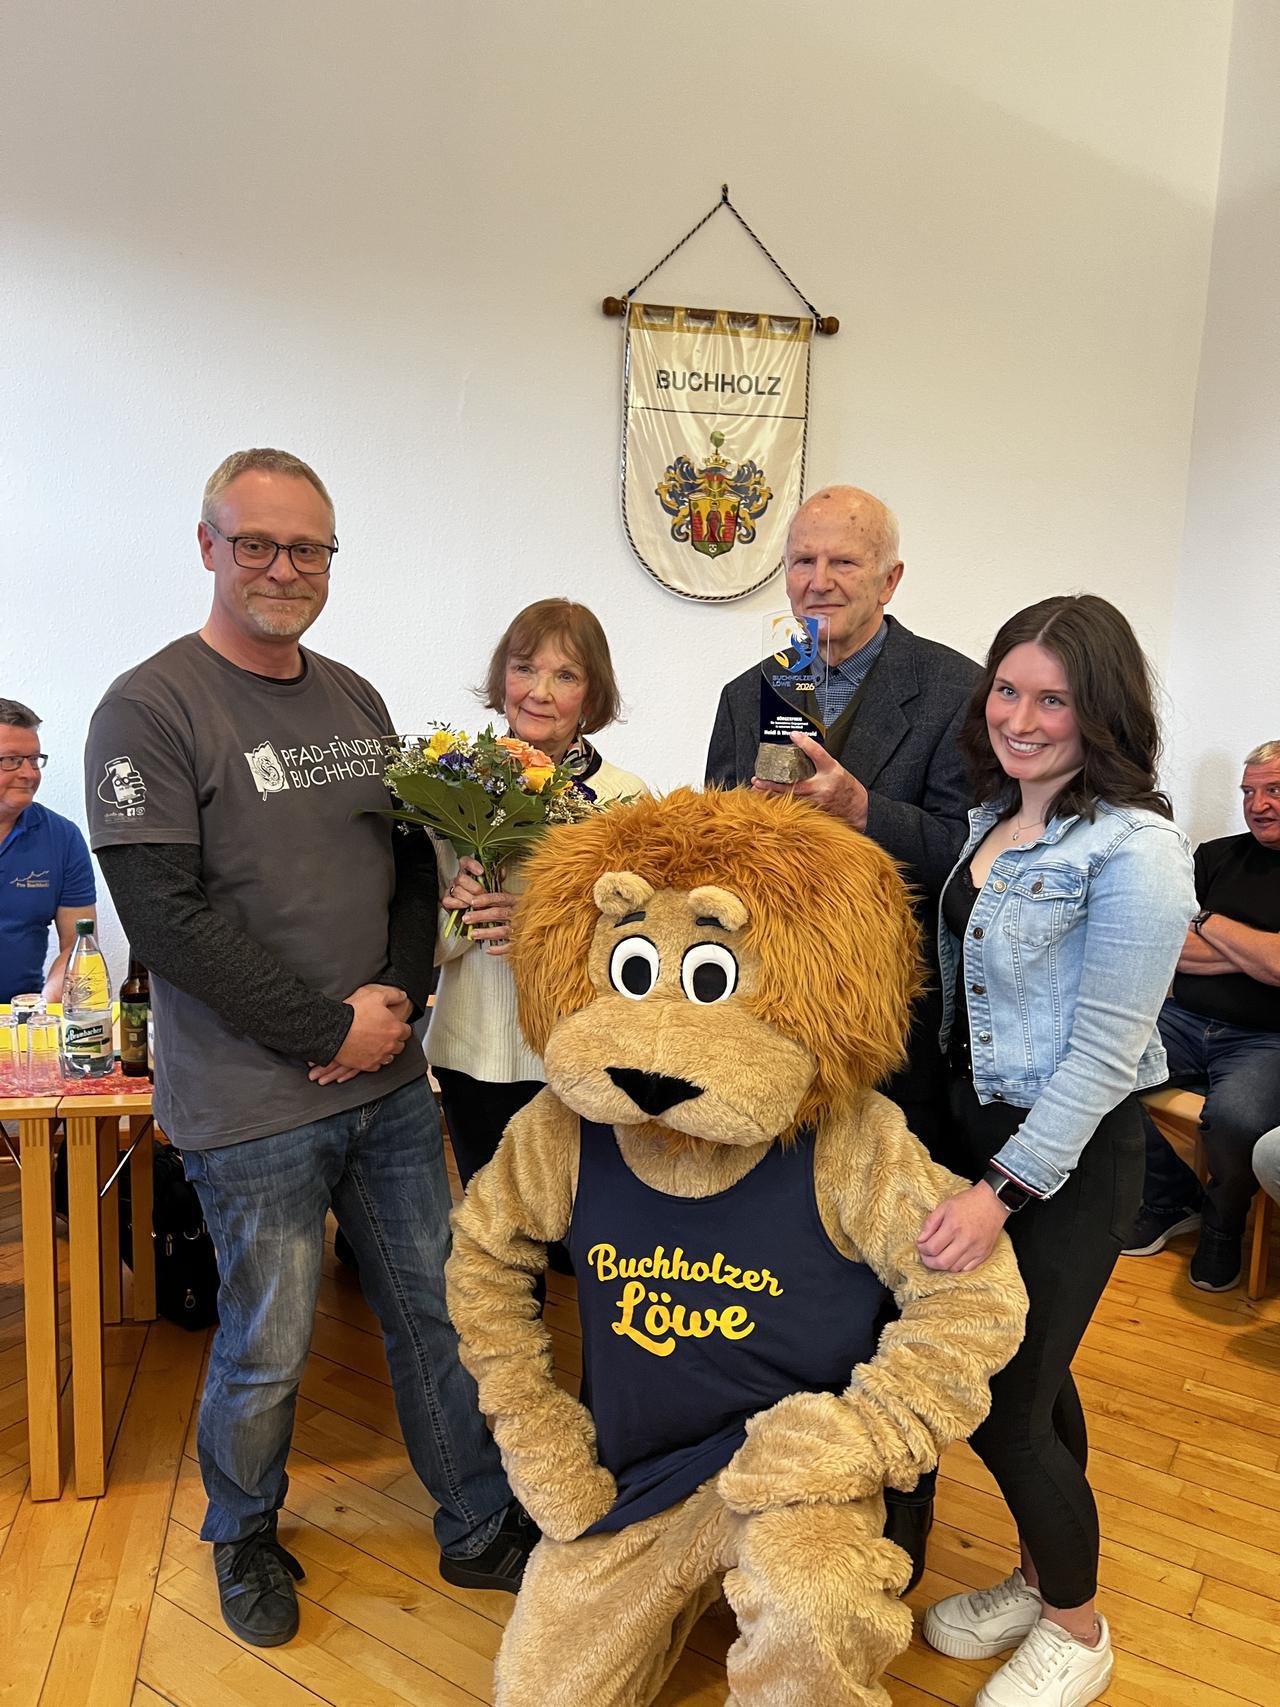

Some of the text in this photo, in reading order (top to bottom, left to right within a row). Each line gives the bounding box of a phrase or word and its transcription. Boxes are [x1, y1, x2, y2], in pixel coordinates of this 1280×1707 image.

[656, 369, 782, 396] BUCHHOLZ
[795, 682, 816, 691] 2026
[289, 758, 381, 789] BUCHHOLZ
[587, 1243, 784, 1297] Buchholzer
[611, 1280, 756, 1357] Löwe
